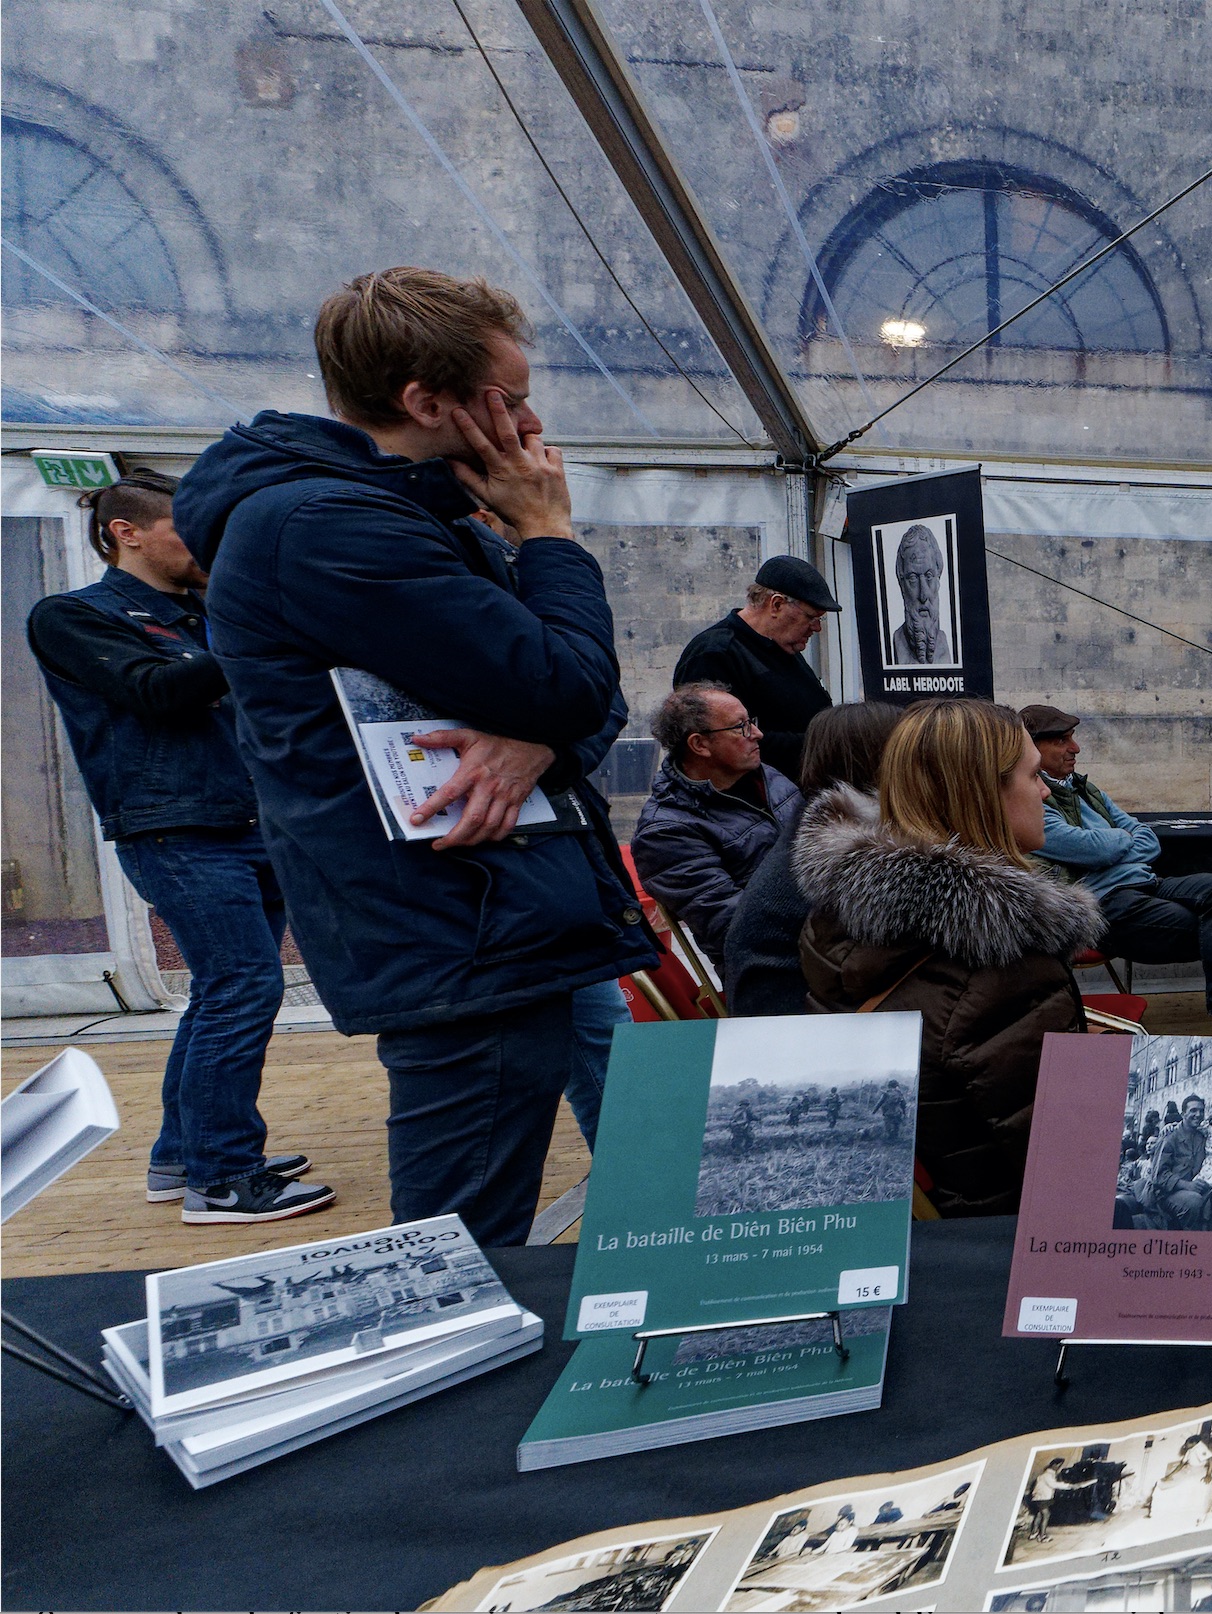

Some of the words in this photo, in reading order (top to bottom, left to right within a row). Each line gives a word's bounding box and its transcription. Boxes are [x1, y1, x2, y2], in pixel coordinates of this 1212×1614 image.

[883, 677, 911, 692] LABEL
[913, 675, 965, 693] HERODOTE
[597, 1234, 618, 1251] La
[626, 1227, 695, 1249] bataille
[701, 1225, 723, 1242] de
[730, 1223, 770, 1240] Diên
[778, 1218, 816, 1236] Biên
[823, 1214, 857, 1234] Phu
[301, 1231, 422, 1263] d'envoi
[705, 1253, 718, 1265] 13
[722, 1252, 749, 1264] mars
[761, 1249, 768, 1260] 7
[772, 1245, 793, 1259] mai
[797, 1243, 823, 1257] 1954
[1030, 1237, 1047, 1253] La
[1054, 1241, 1137, 1258] campagne
[1143, 1238, 1198, 1256] d'Italie
[1123, 1267, 1175, 1281] Septembre
[1179, 1268, 1203, 1280] 1943
[856, 1286, 870, 1298] 15
[873, 1285, 881, 1296] €
[593, 1298, 638, 1311] EXEMPLAIRE
[1032, 1304, 1069, 1313] EXEMPLAIRE
[609, 1310, 620, 1318] DE
[1045, 1314, 1054, 1322] DE
[584, 1318, 641, 1330] CONSULTATION
[1024, 1323, 1072, 1332] CONSULTATION
[569, 1381, 592, 1393] La
[599, 1370, 669, 1390] batalle
[676, 1364, 698, 1378] de
[705, 1357, 747, 1373] Diên
[754, 1349, 793, 1365] Biên
[800, 1344, 834, 1358] Phu
[678, 1381, 691, 1389] 13
[695, 1376, 722, 1386] mars
[746, 1368, 767, 1378] mai
[772, 1363, 799, 1374] 1954
